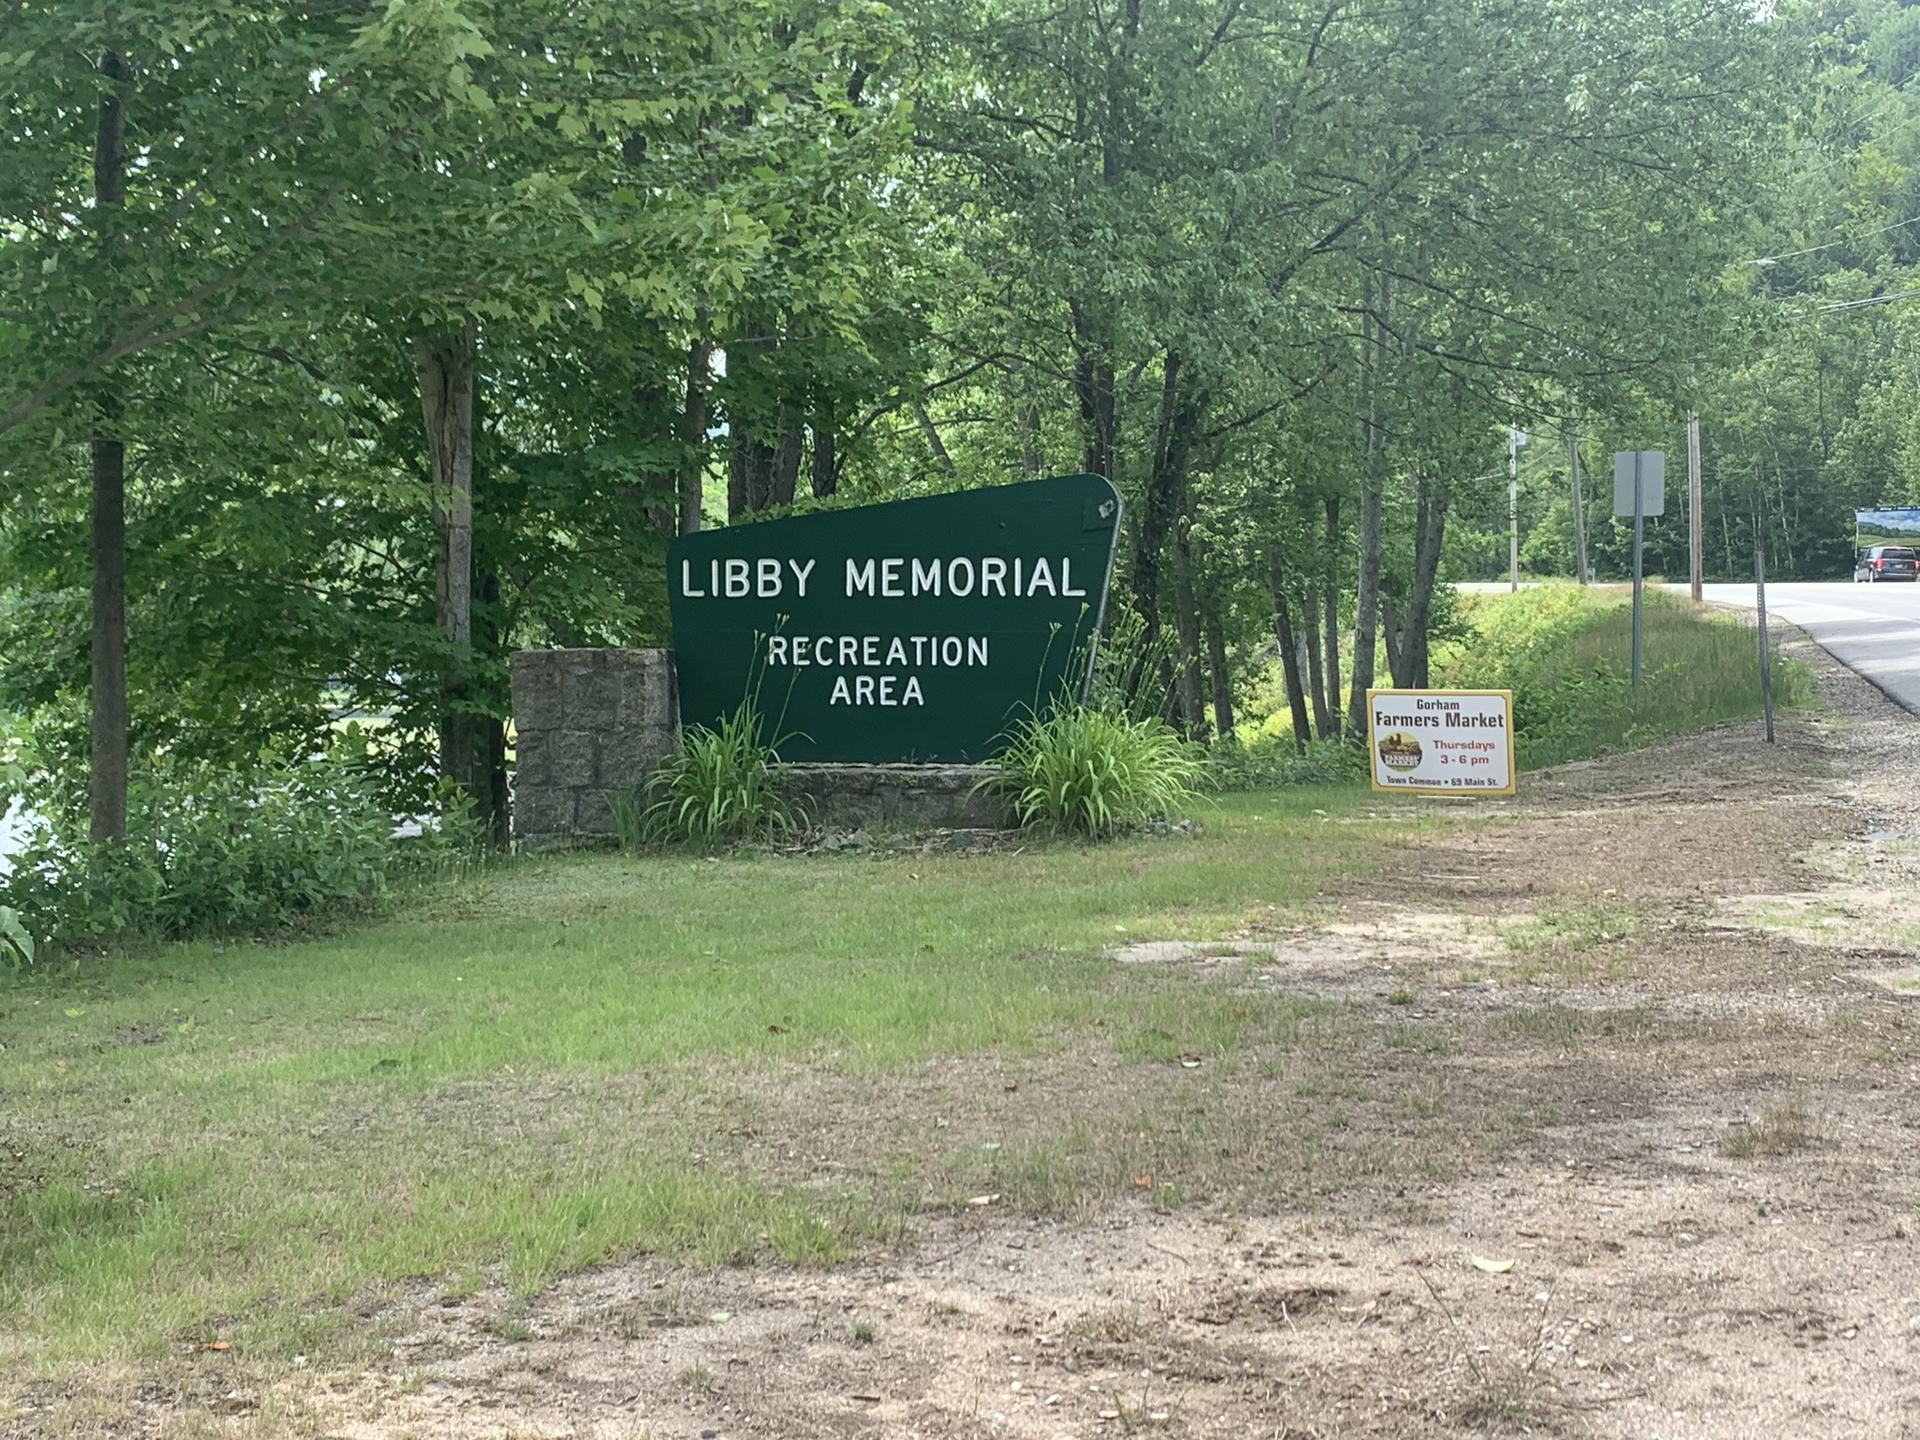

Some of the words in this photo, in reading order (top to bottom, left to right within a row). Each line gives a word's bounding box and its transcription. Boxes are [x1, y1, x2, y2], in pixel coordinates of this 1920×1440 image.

[682, 558, 816, 598] LIBBY
[846, 557, 1087, 597] MEMORIAL
[768, 636, 989, 667] RECREATION
[830, 675, 925, 706] AREA
[1417, 698, 1460, 710] Gorham
[1376, 711, 1440, 727] Farmers
[1446, 712, 1504, 728] Market
[1433, 740, 1496, 752] Thursdays
[1440, 755, 1449, 765] 3
[1459, 755, 1467, 765] 6
[1471, 757, 1489, 766] pm
[1387, 775, 1407, 785] Town
[1409, 776, 1442, 786] Common
[1451, 777, 1462, 786] 69
[1464, 777, 1485, 786] Main
[1487, 777, 1499, 786] St.
